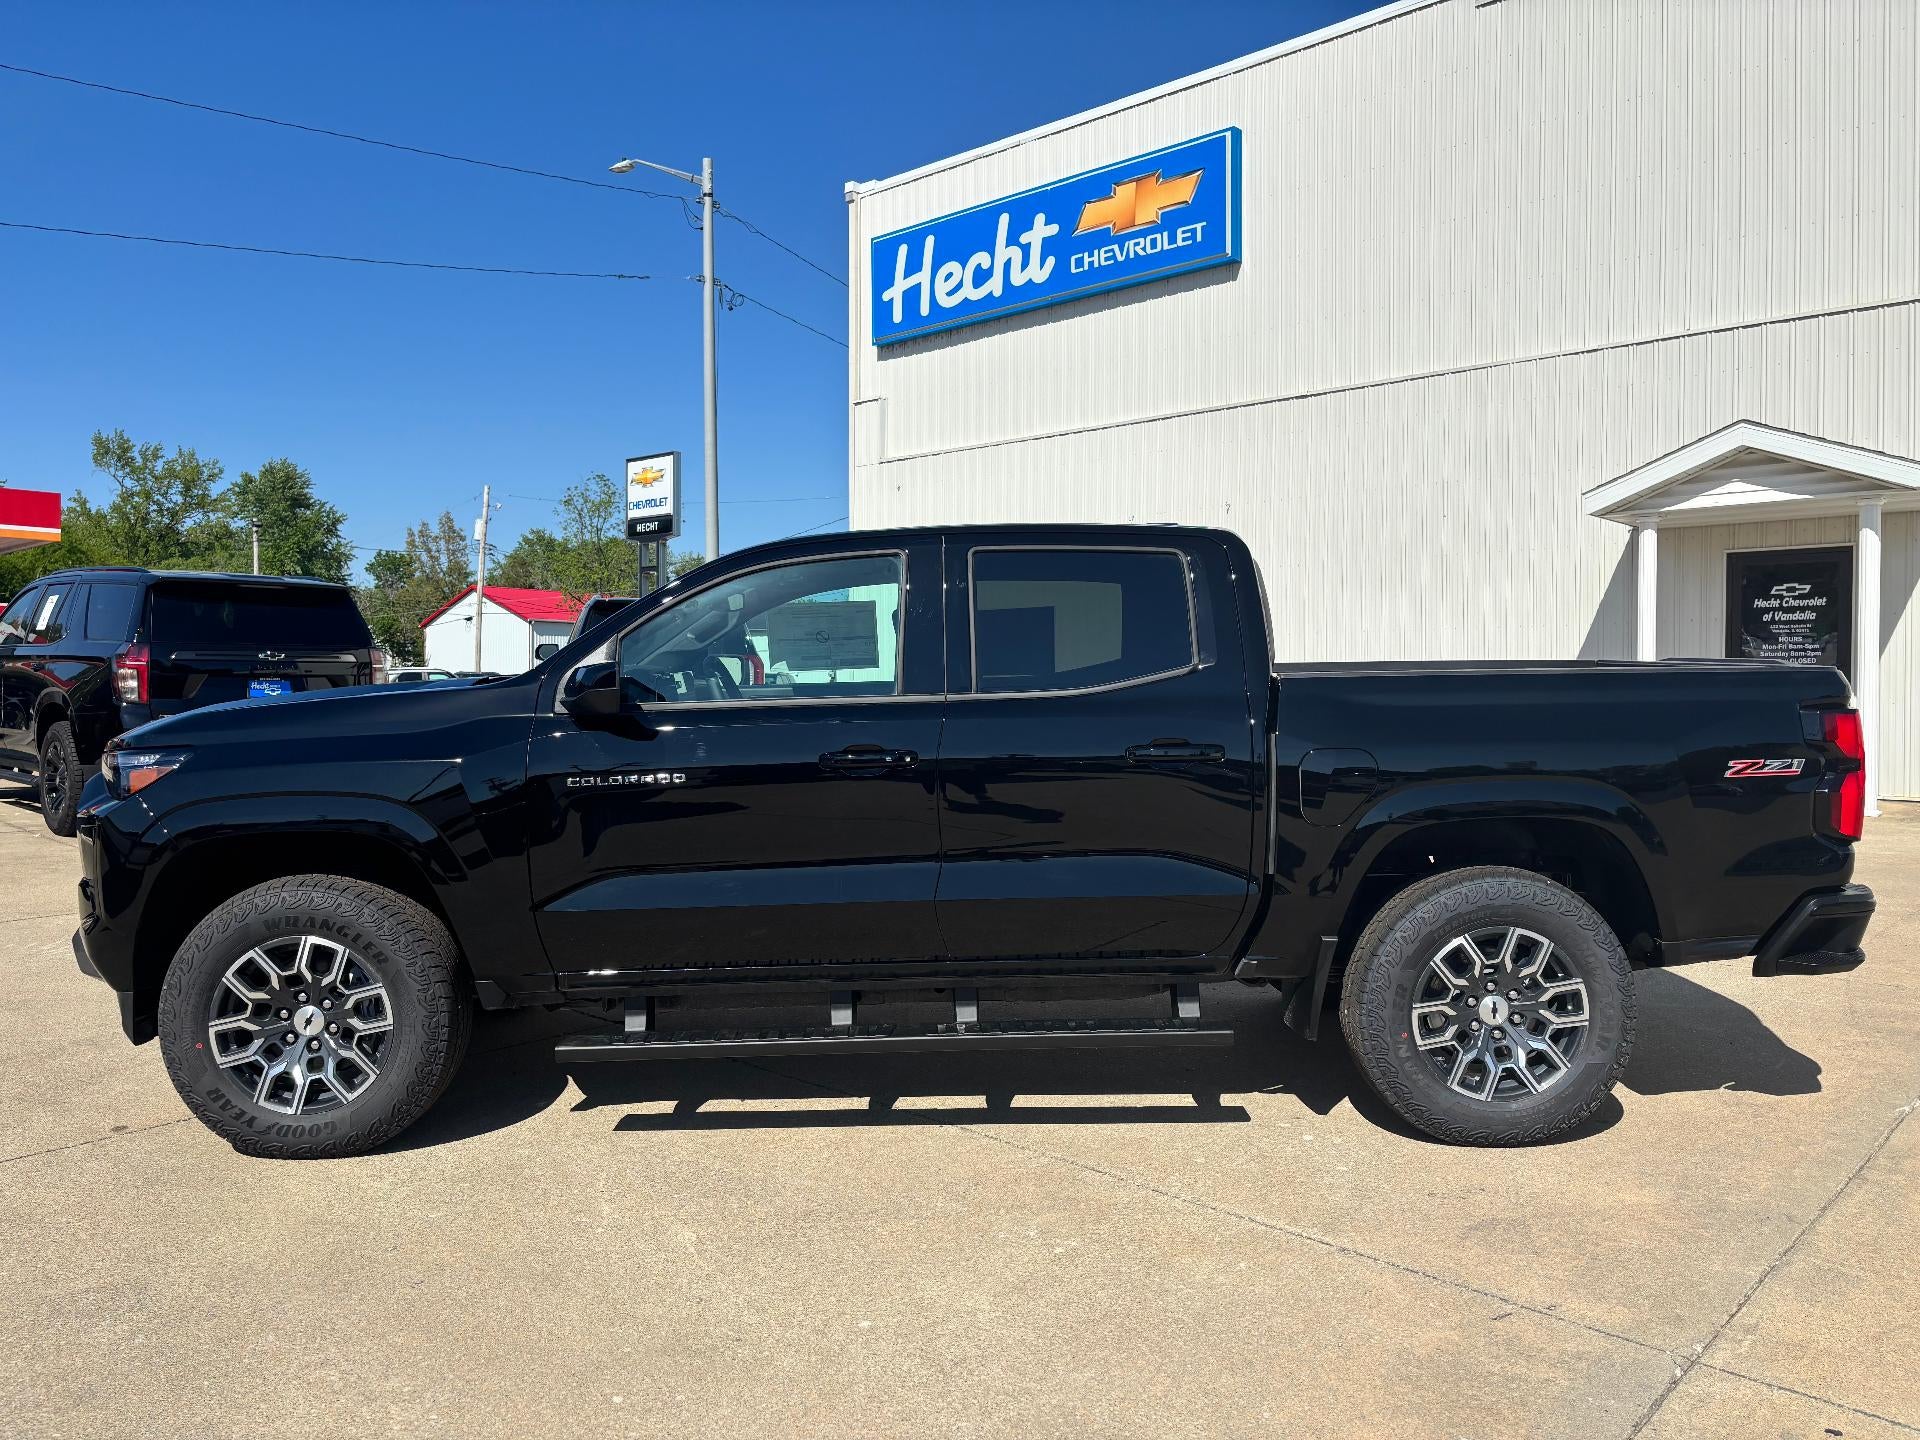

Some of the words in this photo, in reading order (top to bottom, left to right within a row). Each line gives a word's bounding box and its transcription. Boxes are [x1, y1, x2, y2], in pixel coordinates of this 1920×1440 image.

[1070, 221, 1207, 274] CHEVROLET
[881, 212, 1060, 324] Hecht
[628, 496, 668, 511] CHEVROLET
[636, 521, 659, 533] HECHT
[1753, 597, 1781, 608] Hecht
[1782, 596, 1828, 607] Chevrolet
[1762, 611, 1774, 622] of
[1774, 610, 1817, 621] Vandalia
[1724, 758, 1806, 778] Z71
[566, 773, 687, 787] COLORADO
[263, 914, 391, 966] WRANGLER
